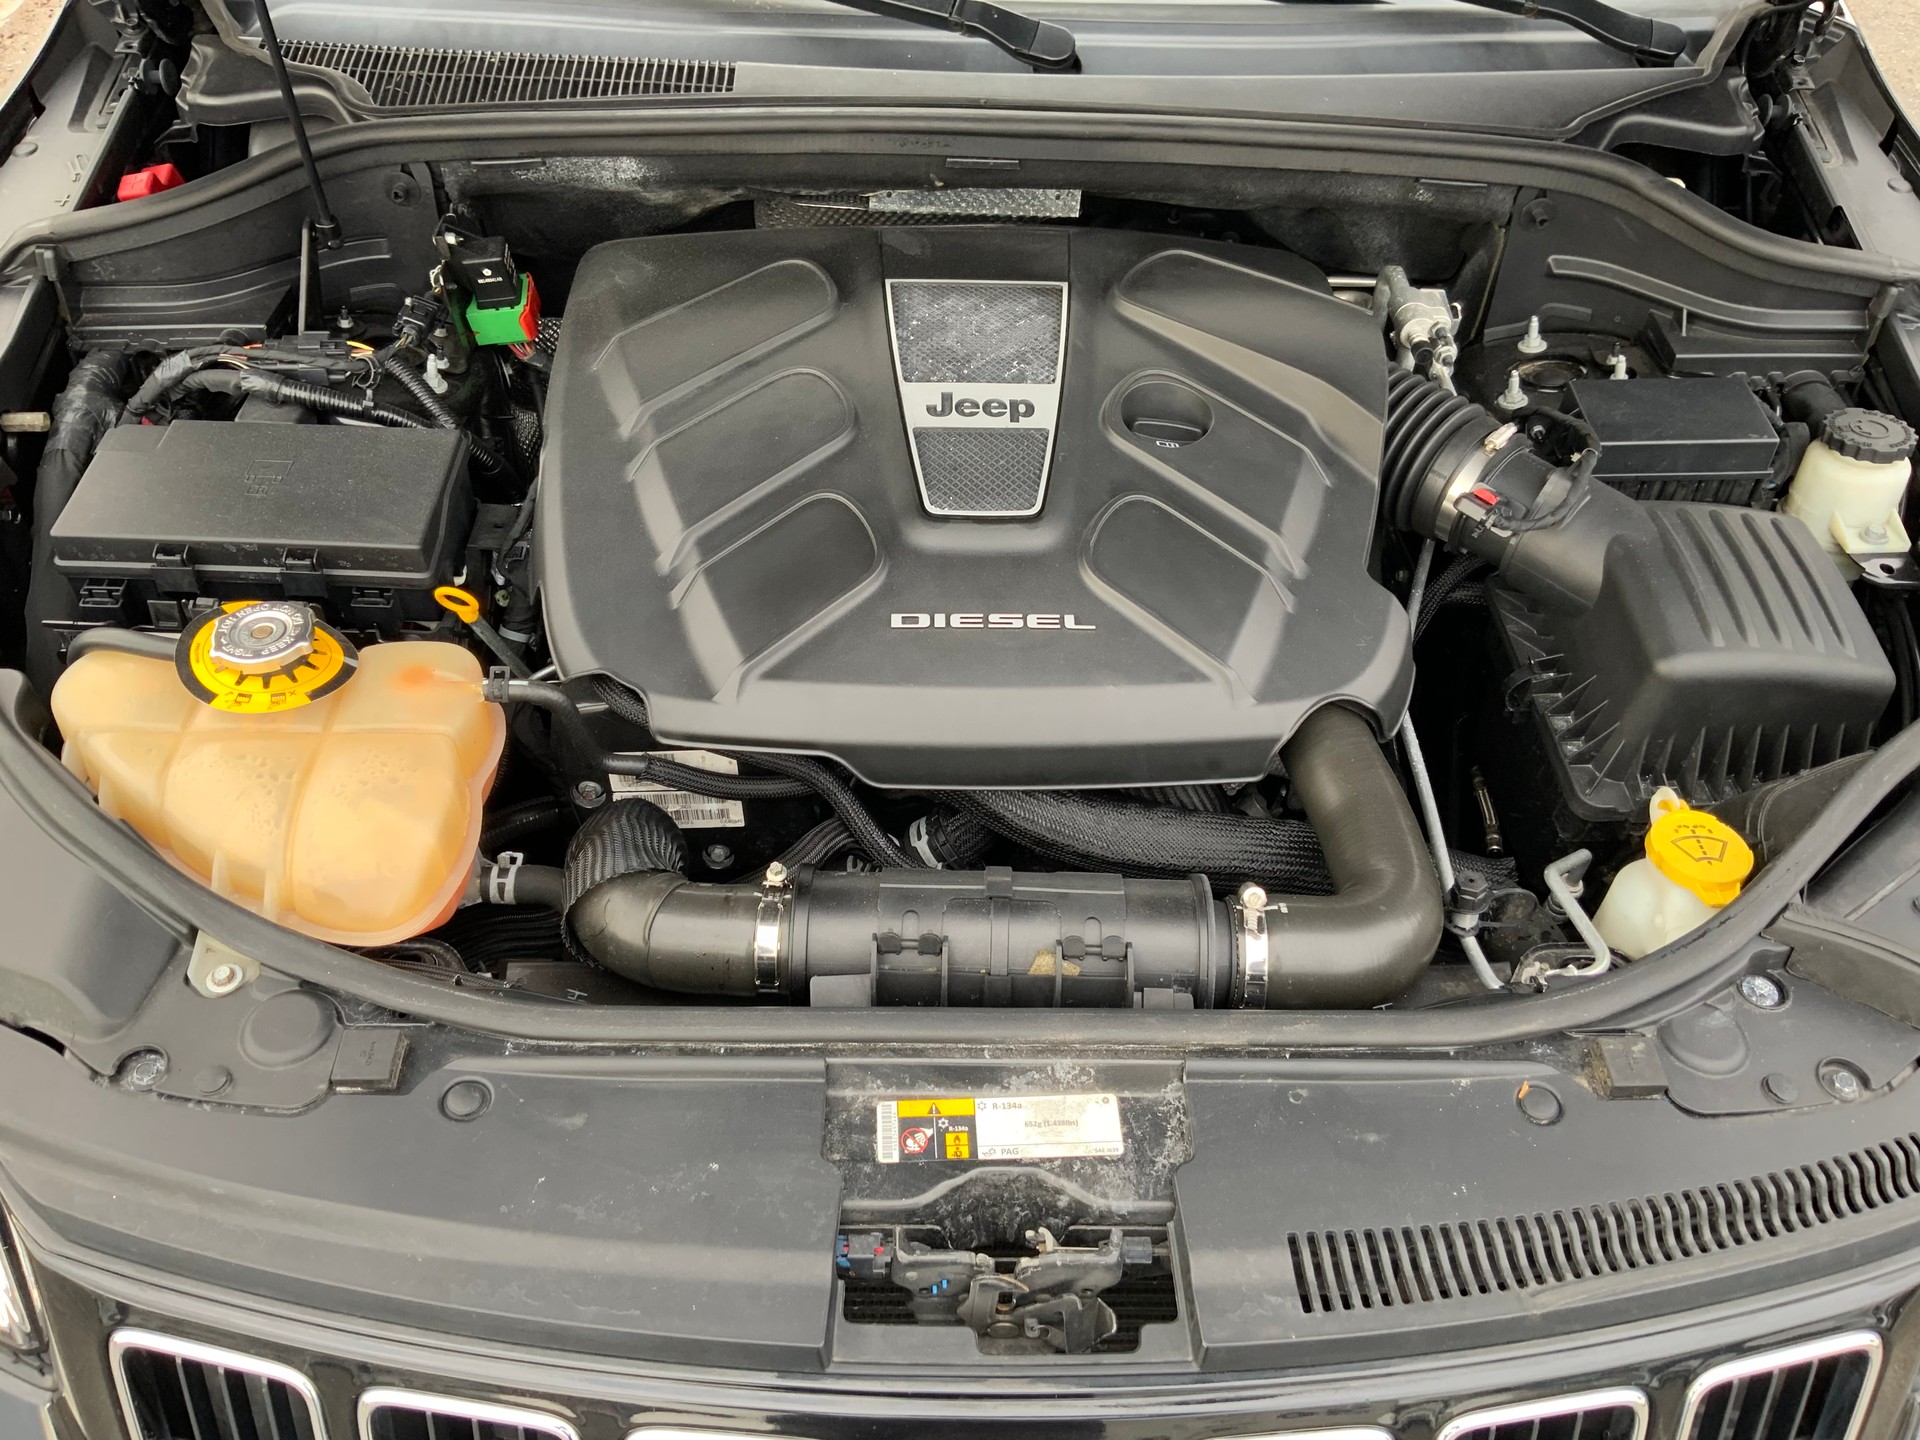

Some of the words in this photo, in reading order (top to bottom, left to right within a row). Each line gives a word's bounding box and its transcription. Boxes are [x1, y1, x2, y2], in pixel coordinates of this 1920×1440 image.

[925, 391, 1036, 423] Jeep
[236, 603, 270, 618] OPEN
[272, 603, 296, 617] NOT
[218, 617, 236, 633] HOT
[890, 613, 1097, 631] DIESEL
[261, 637, 295, 655] KEEP
[991, 1101, 1023, 1111] R-134a
[948, 1125, 969, 1133] R-134a
[1024, 1120, 1043, 1129] 652g
[1000, 1146, 1020, 1157] PAG
